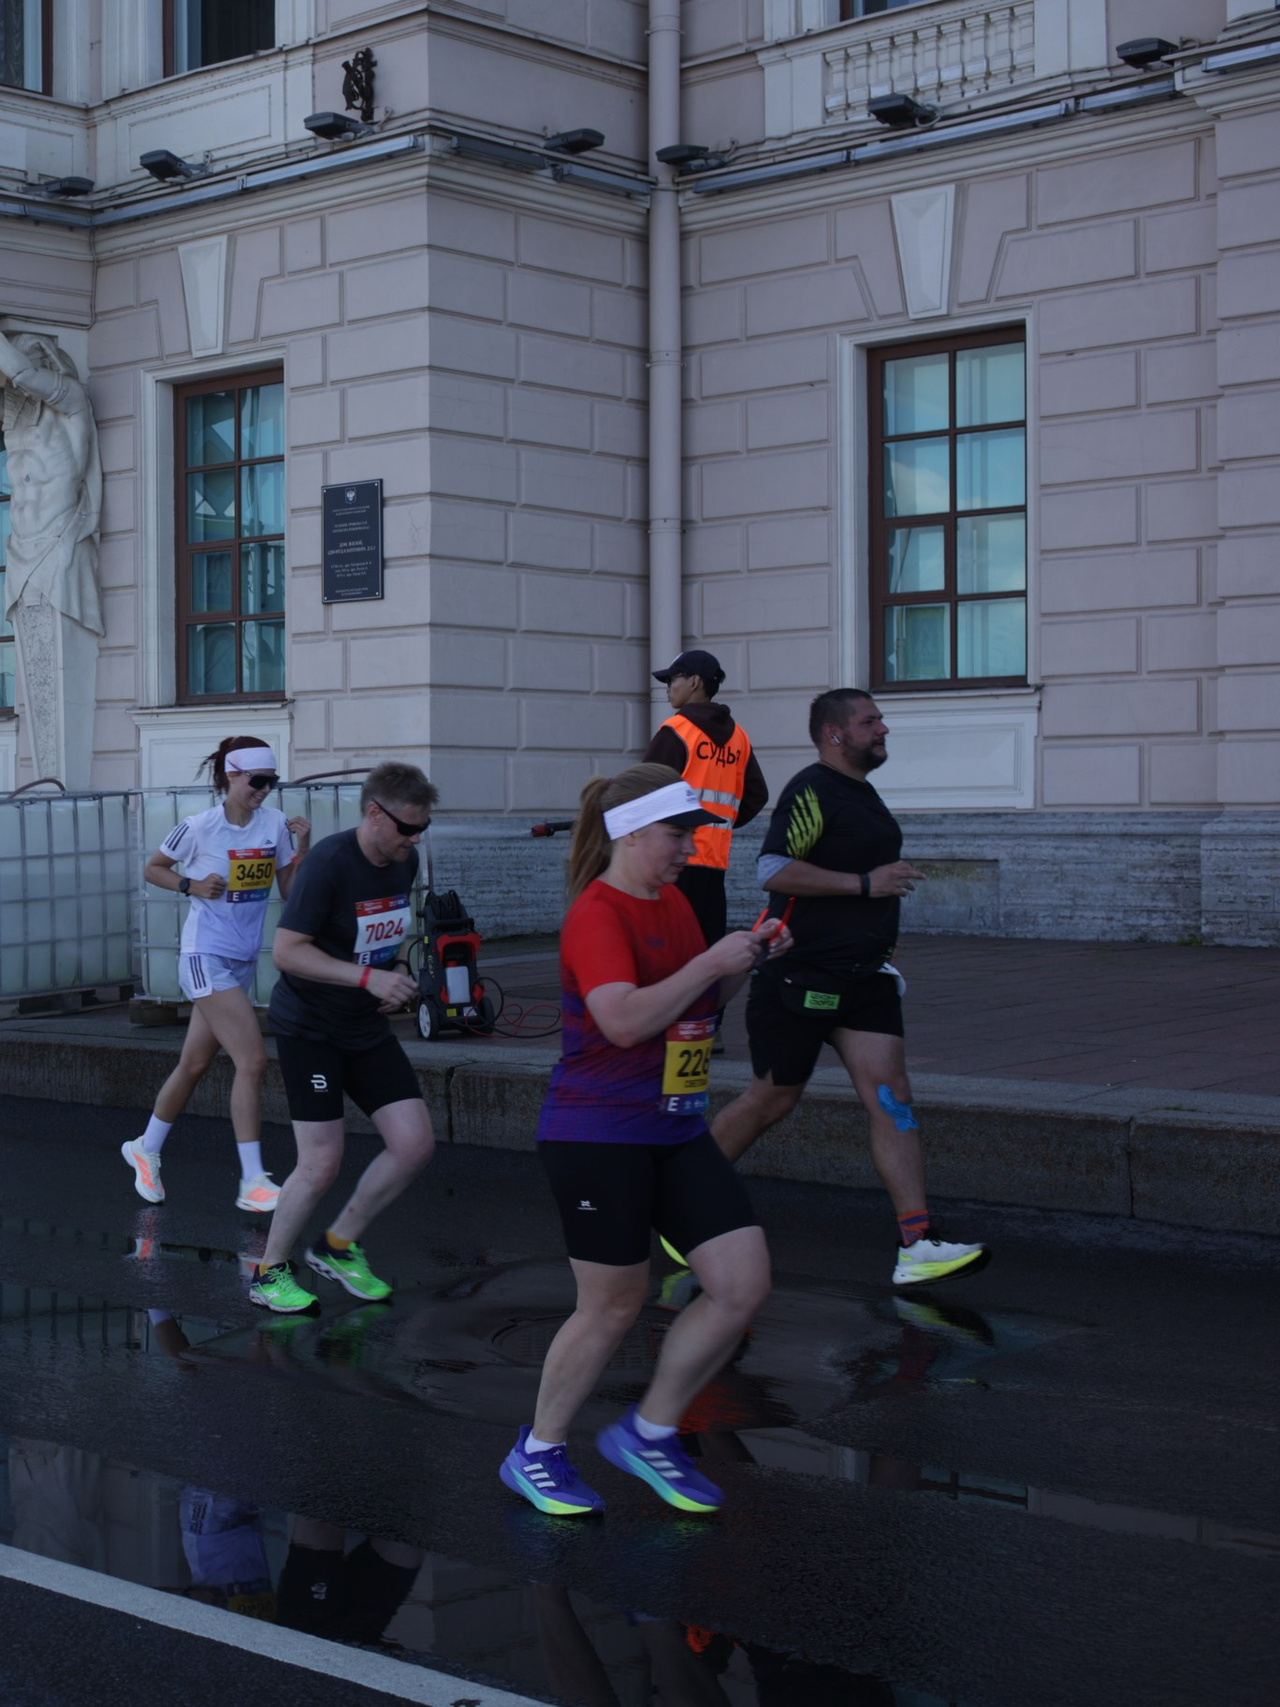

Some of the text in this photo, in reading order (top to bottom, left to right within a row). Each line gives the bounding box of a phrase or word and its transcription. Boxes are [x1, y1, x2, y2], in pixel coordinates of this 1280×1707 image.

[236, 863, 272, 881] 3450
[232, 892, 240, 901] E
[366, 917, 404, 944] 7024
[667, 1097, 680, 1112] E
